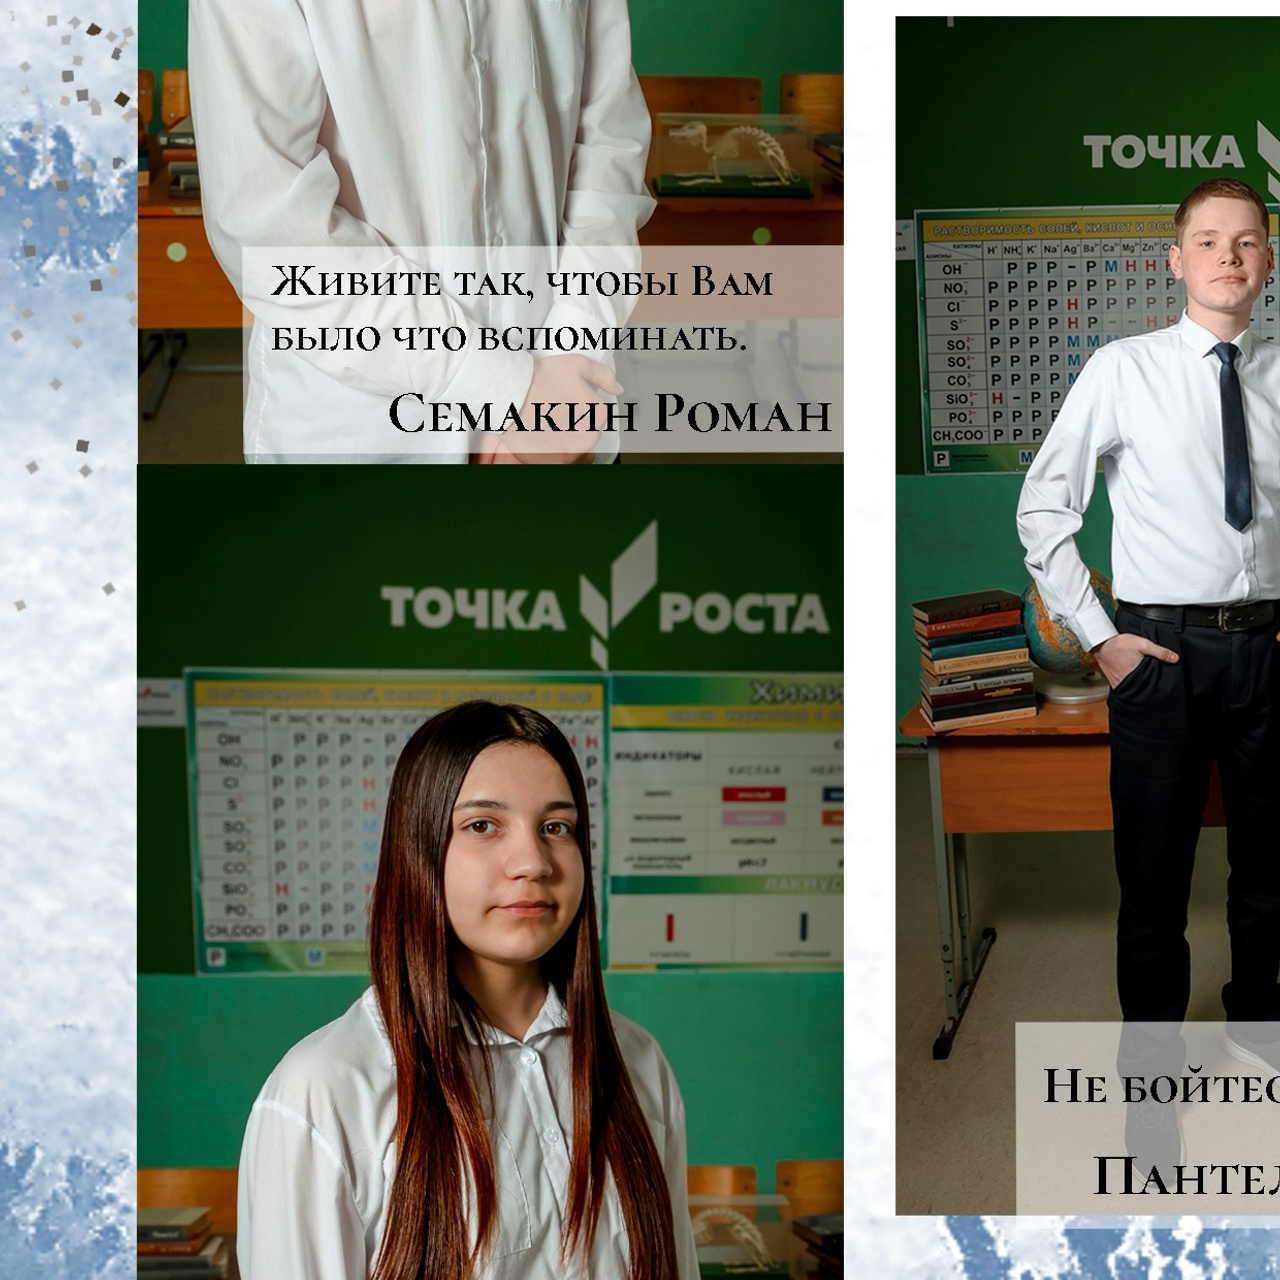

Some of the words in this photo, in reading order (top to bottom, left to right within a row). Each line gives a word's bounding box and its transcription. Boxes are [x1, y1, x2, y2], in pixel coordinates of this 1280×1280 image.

[1083, 134, 1245, 169] ТОЧКА
[934, 224, 1035, 236] РАСТВОРИМОСТЬ
[1086, 222, 1131, 233] КИСЛОТ
[1135, 222, 1144, 232] И
[381, 585, 567, 631] ТОЧКА
[660, 593, 830, 634] РОСТА
